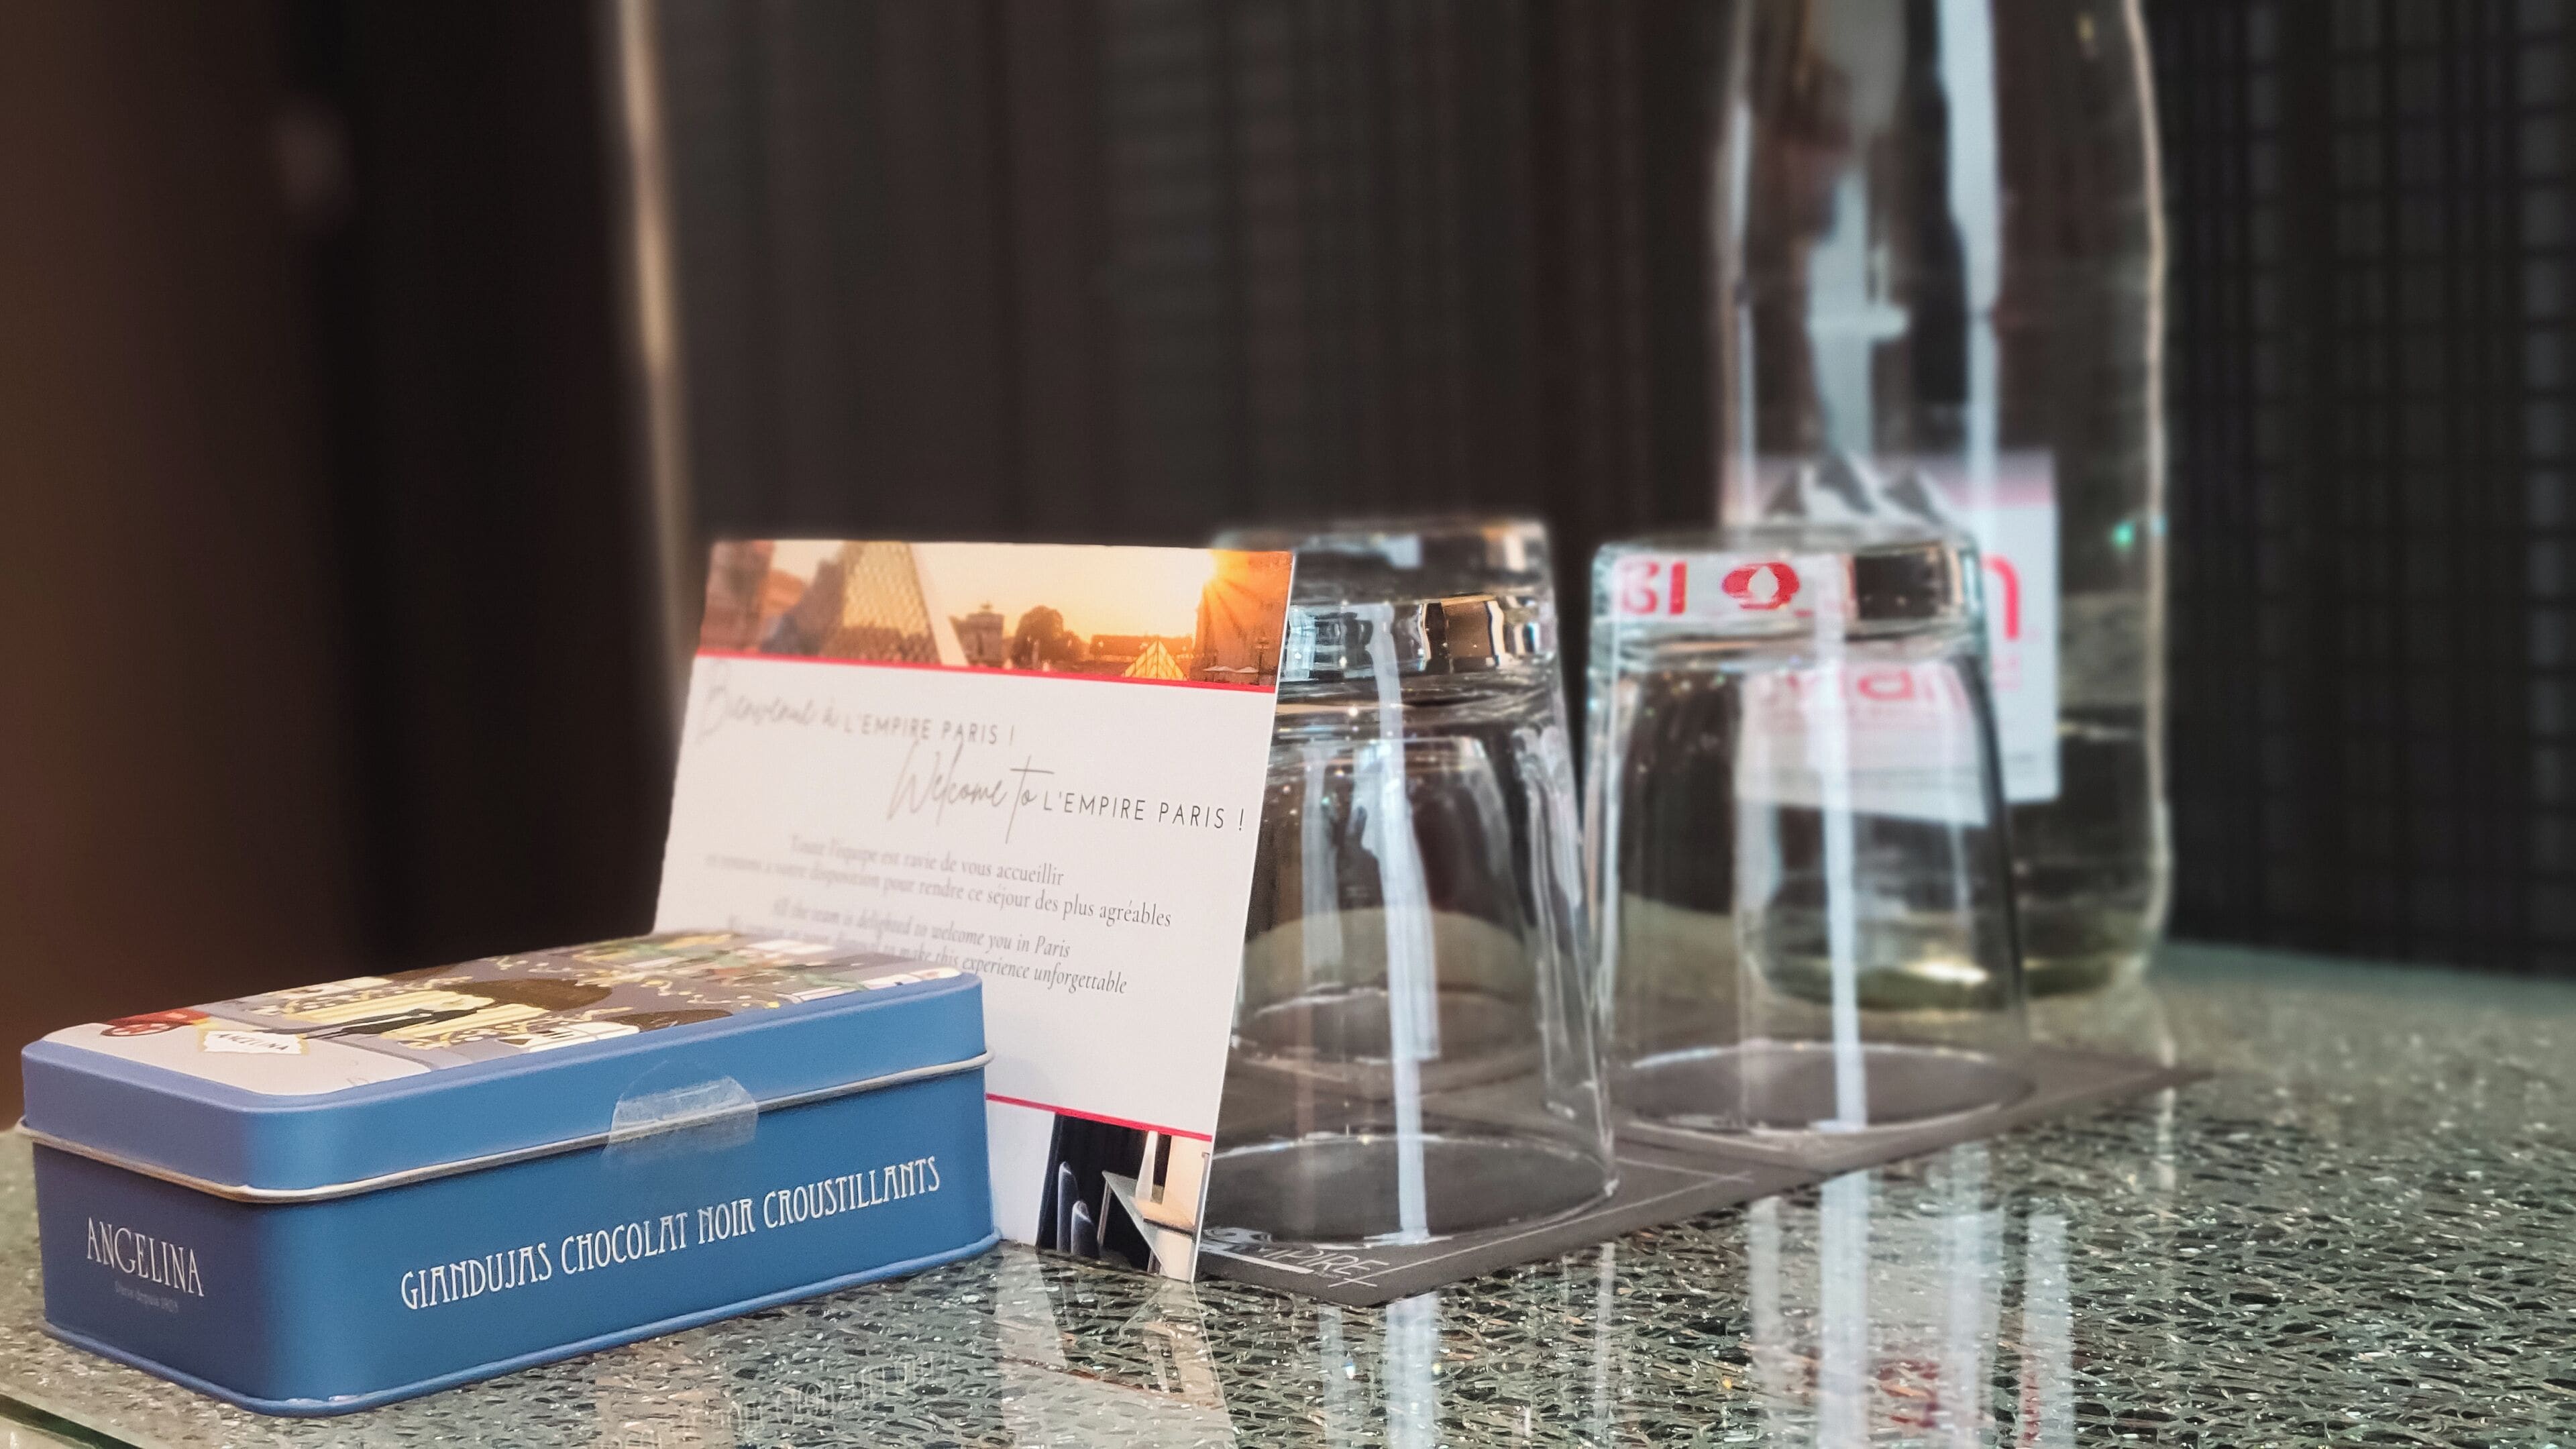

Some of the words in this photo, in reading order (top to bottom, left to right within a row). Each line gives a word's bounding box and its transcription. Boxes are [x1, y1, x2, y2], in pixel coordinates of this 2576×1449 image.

[843, 714, 932, 740] L'EMPIRE
[942, 720, 998, 745] PARIS
[886, 739, 1007, 826] Welcome
[1044, 790, 1146, 820] L'EMPIRE
[1159, 802, 1225, 829] PARIS
[941, 851, 957, 872] de
[961, 861, 992, 877] vous
[996, 863, 1064, 885] accueillir
[919, 876, 964, 900] rendre
[968, 888, 983, 902] ce
[987, 883, 1030, 911] séjour
[1035, 889, 1058, 912] des
[1063, 894, 1094, 920] plus
[1099, 900, 1171, 927] agréables
[930, 921, 984, 946] welcome
[985, 936, 1012, 955] you
[1016, 933, 1030, 952] in
[1034, 936, 1070, 958] Paris
[935, 945, 959, 967] this
[962, 955, 1030, 980] experience
[1034, 963, 1127, 994] unforgettable
[87, 1216, 205, 1297] ANGELINA
[400, 1242, 553, 1311] GIANDUJAS
[561, 1210, 689, 1275] CHOCOLAT
[698, 1197, 757, 1246] NOIR
[763, 1155, 941, 1230] CROUSTILLANTS
